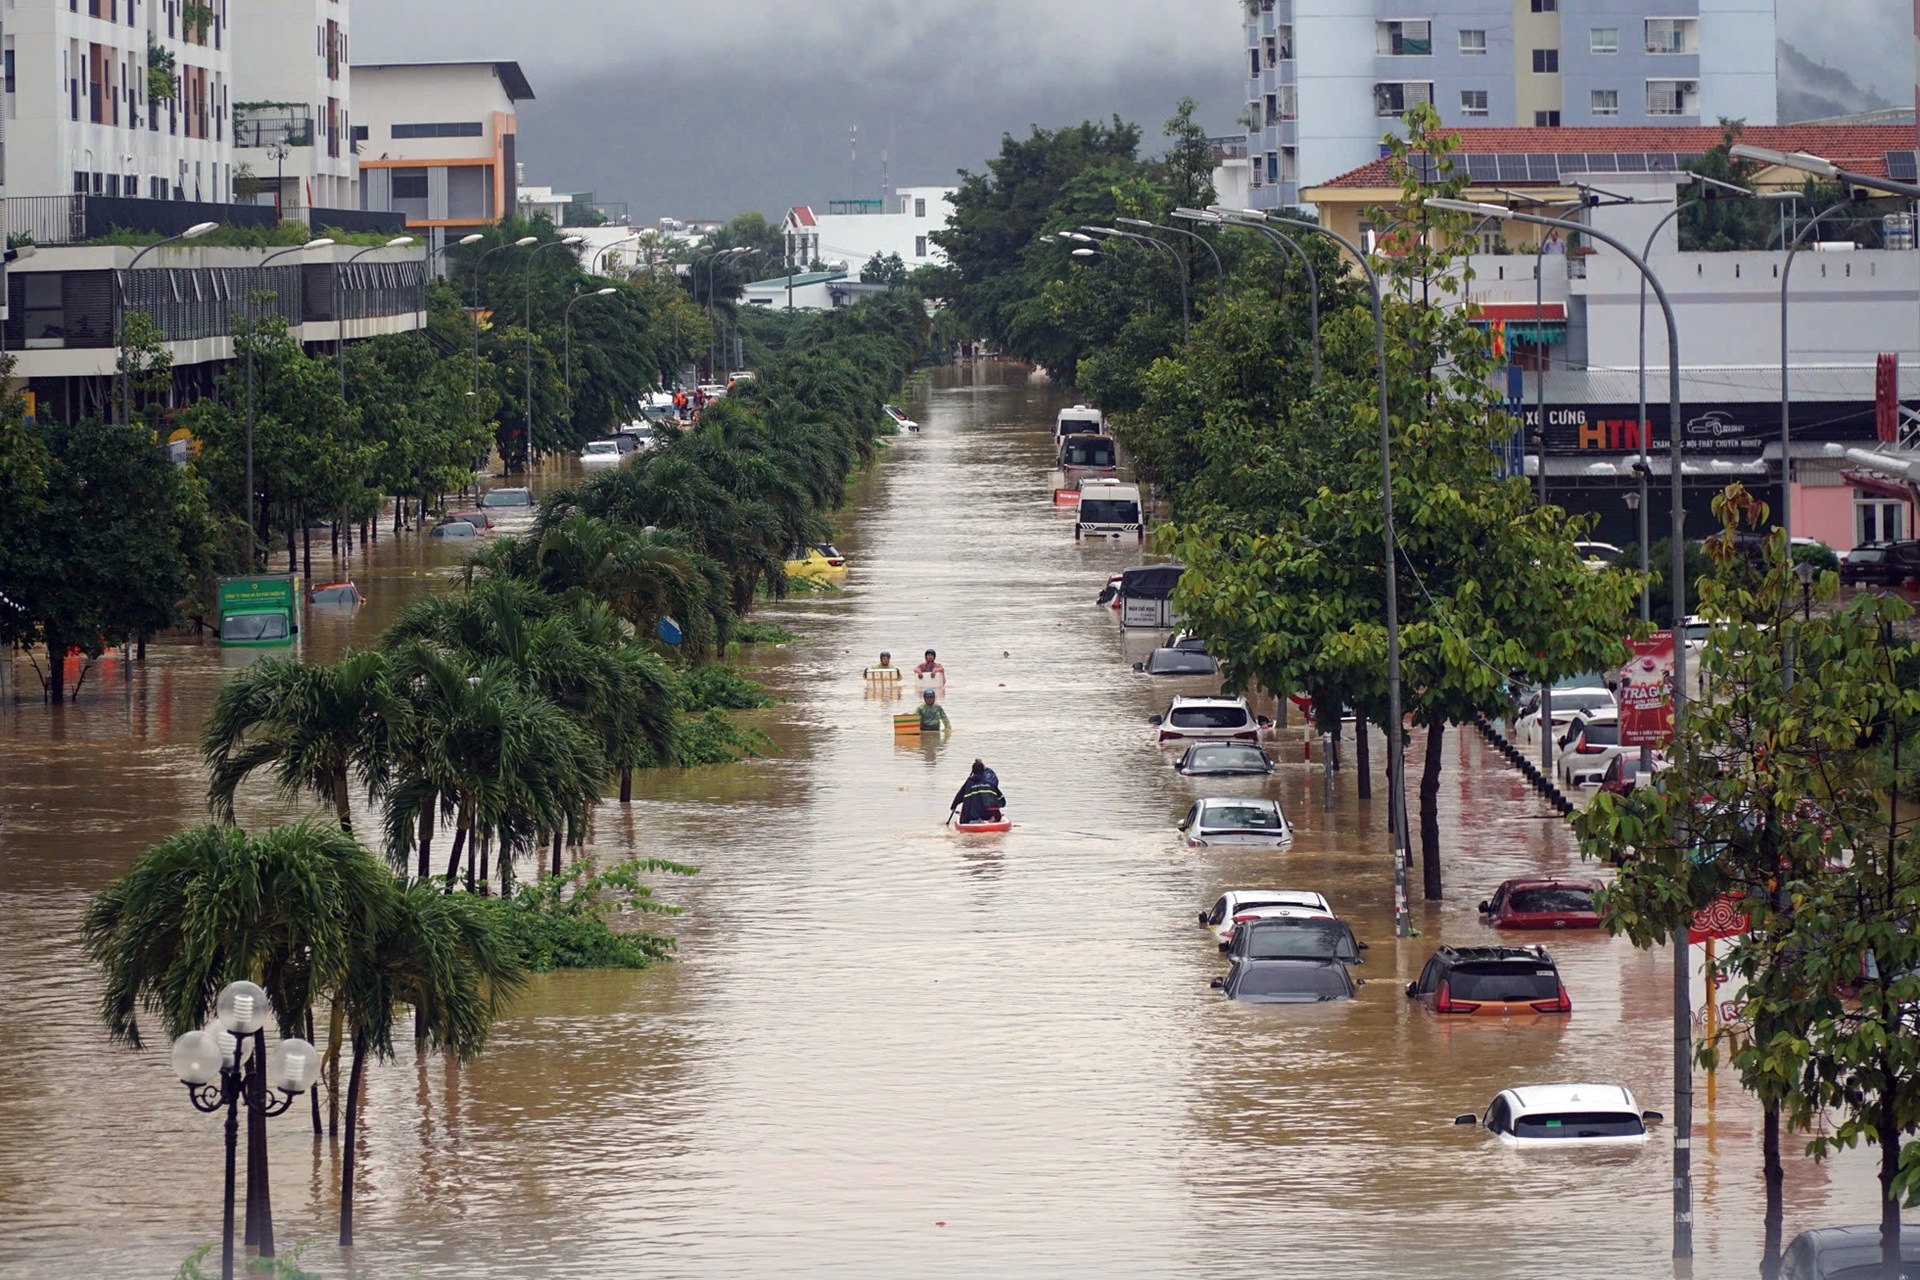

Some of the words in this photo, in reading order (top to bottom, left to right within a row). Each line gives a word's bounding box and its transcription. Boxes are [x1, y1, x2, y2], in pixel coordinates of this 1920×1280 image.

[1549, 409, 1586, 425] CƯNG
[1579, 420, 1652, 449] HTM
[1624, 682, 1648, 699] TRẢ
